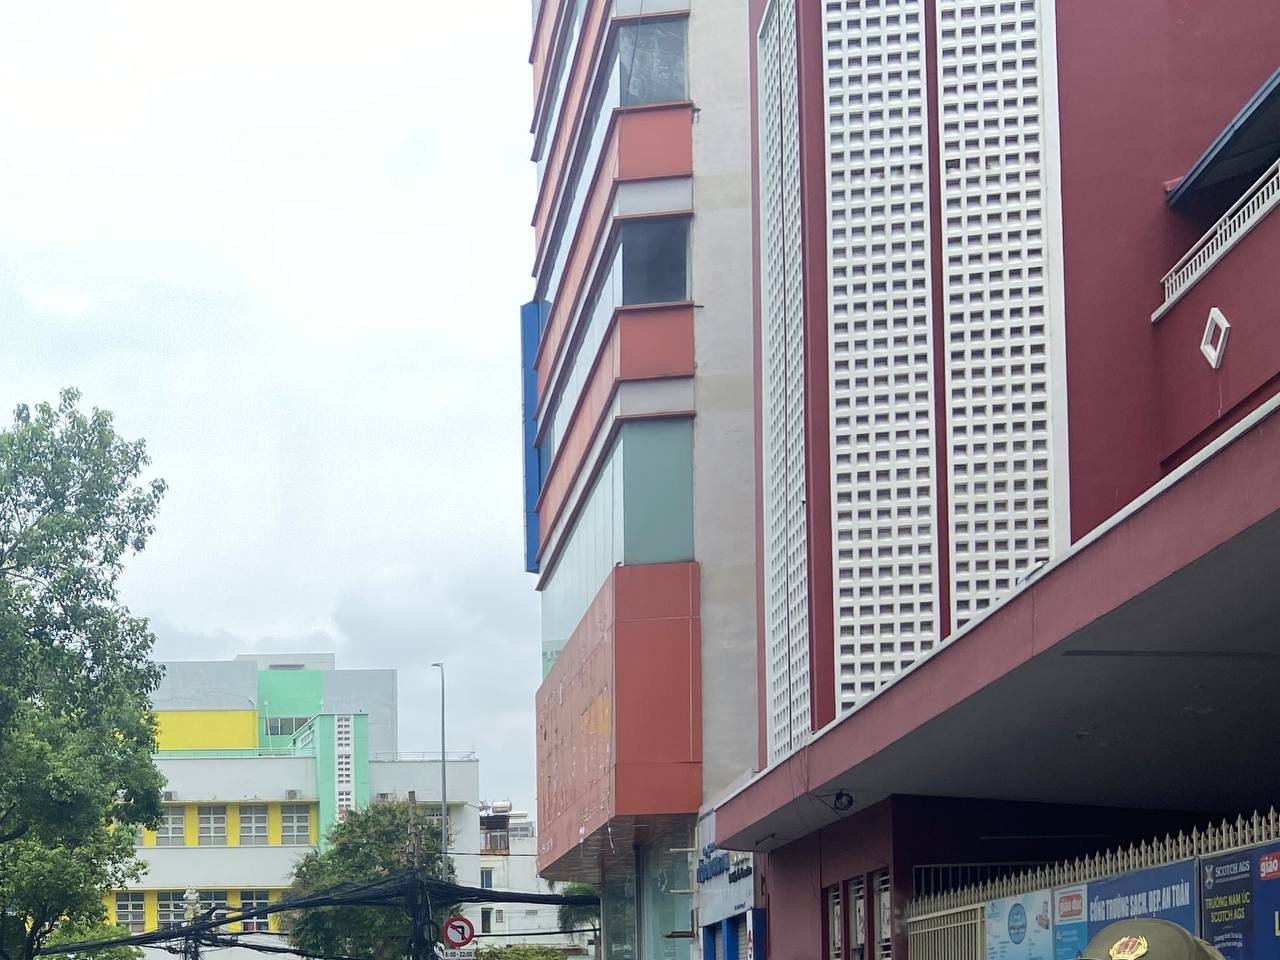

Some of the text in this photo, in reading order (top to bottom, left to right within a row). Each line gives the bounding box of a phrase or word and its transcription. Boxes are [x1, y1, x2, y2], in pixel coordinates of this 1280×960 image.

[1215, 860, 1250, 878] SCOTCH AGS
[1228, 893, 1241, 907] NAM
[1210, 907, 1246, 924] SCOTCH AGS
